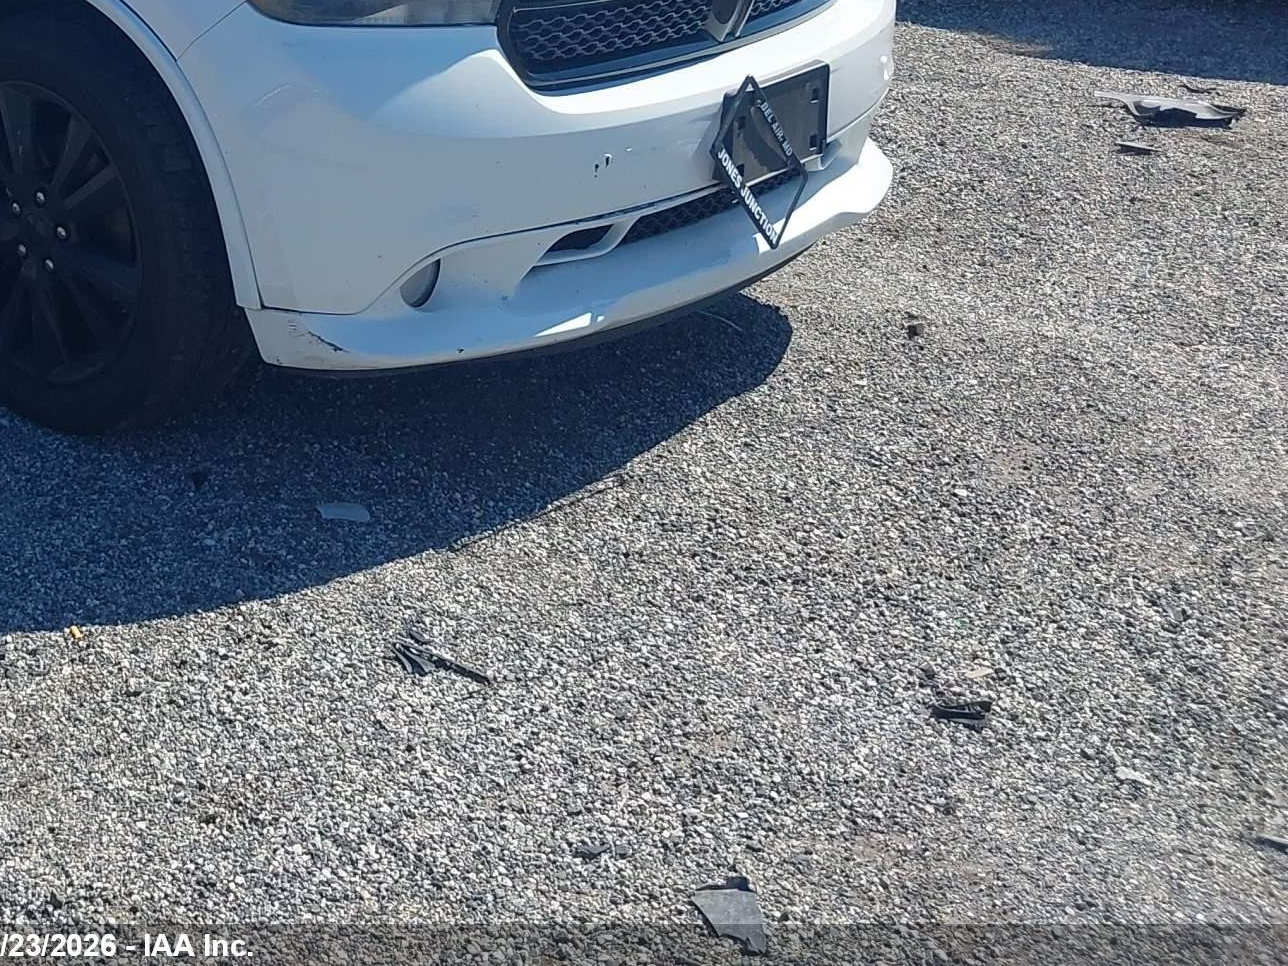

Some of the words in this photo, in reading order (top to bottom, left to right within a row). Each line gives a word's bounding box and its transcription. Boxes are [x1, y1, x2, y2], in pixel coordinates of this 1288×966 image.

[760, 102, 775, 123] BEL
[781, 140, 793, 156] MD
[717, 148, 743, 189] JONES
[740, 187, 779, 245] JUNCTION
